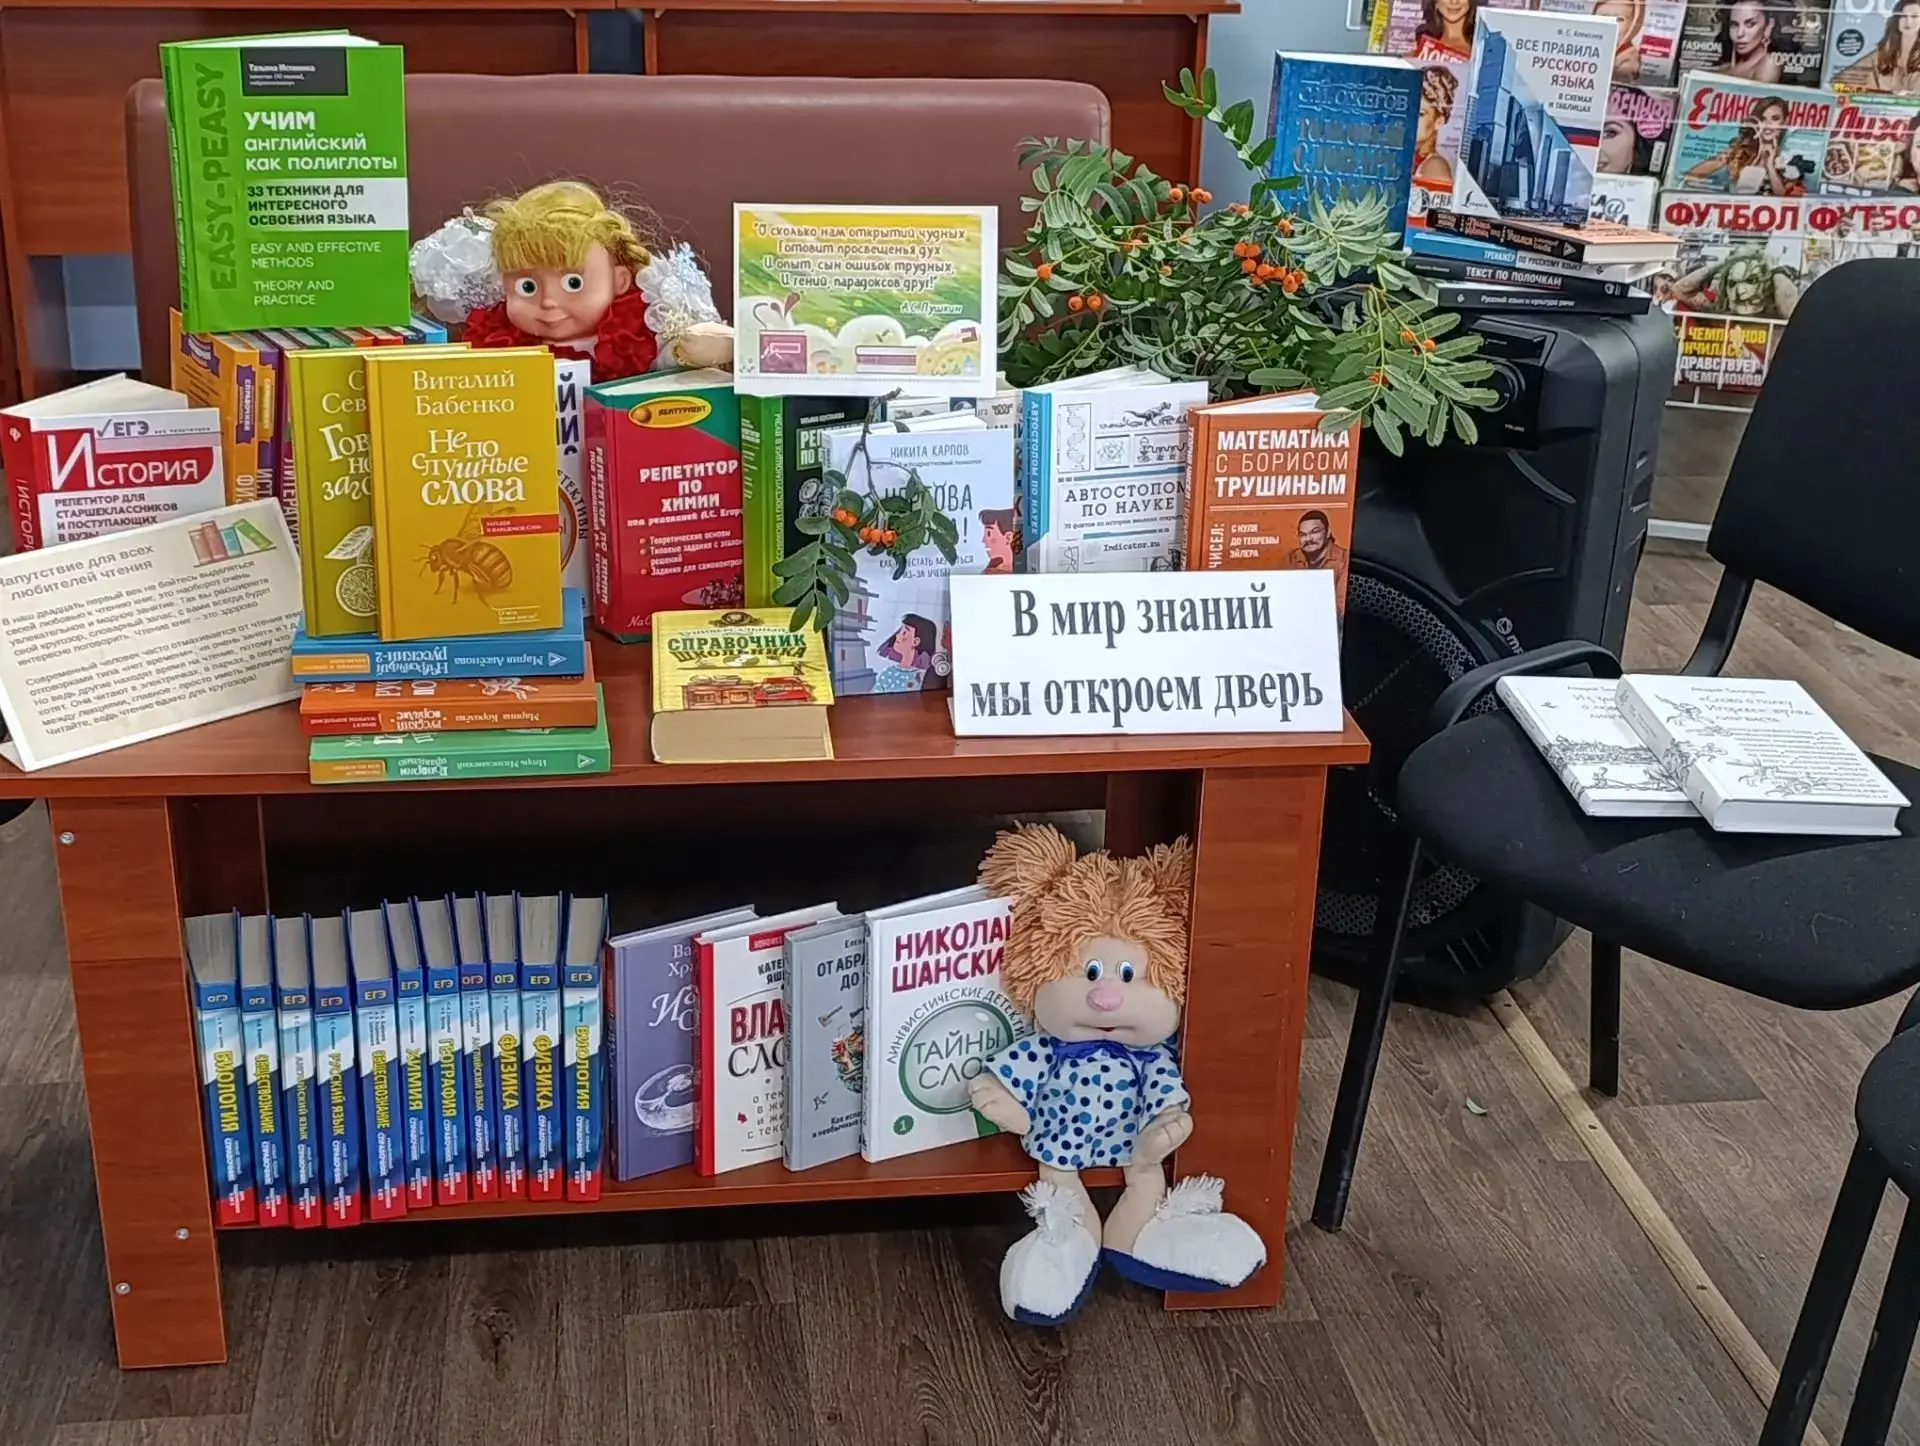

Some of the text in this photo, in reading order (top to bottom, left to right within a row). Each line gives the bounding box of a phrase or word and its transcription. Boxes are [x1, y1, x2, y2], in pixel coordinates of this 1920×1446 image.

[1515, 38, 1600, 58] ВСЕ ПРАВИЛА
[1532, 56, 1598, 74] РУССКОГО
[1550, 75, 1595, 90] ЯЗЫКА
[1565, 94, 1592, 102] СХЕМАХ
[1555, 102, 1591, 113] ТАБЛИЦАХ
[244, 111, 315, 131] УЧИМ
[245, 133, 366, 151] английский
[246, 156, 397, 171] как полиглоты
[195, 63, 238, 290] EASY-PEASY
[247, 185, 364, 198] 33 ТЕХНИКИ ДЛЯ
[249, 199, 348, 212] ИНТЕРЕСНОГО
[249, 213, 376, 226] ОСВОЕНИЯ ЯЗЫКА
[1665, 204, 1798, 231] ФУТБОЛ
[771, 227, 965, 240] сколько нам открытий чудных
[251, 241, 381, 254] EASY AND EFFECTIVE
[779, 243, 941, 257] Готовит просвещенья дух
[252, 257, 314, 268] METHODS
[765, 258, 774, 269] И
[818, 261, 841, 271] сын
[845, 260, 890, 271] ошибок
[1528, 257, 1561, 269] РУССКОМУ
[781, 275, 791, 286] И
[834, 278, 900, 290] парадоксов
[1466, 266, 1562, 287] ТЕКСТ ПО ПОЛОЧКАМ
[254, 280, 334, 291] THEORY AND
[254, 295, 316, 305] PRACTICE
[1481, 295, 1507, 304] Русский
[921, 302, 962, 314] Пушкин
[1689, 327, 1767, 344] ЧЕМПНОВ
[412, 370, 515, 391] Виталий
[416, 395, 515, 416] Бабенко
[113, 420, 149, 437] ЕГЭ
[1218, 429, 1350, 450] МАТЕМАТИКА
[890, 444, 969, 458] НИКИТА КАРПОВ
[1031, 401, 1040, 535] АВТОСТОПОМ ПО НАУКЕ
[1216, 451, 1348, 473] С БОРИСОМ
[640, 460, 738, 483] РЕПЕТИТОР
[421, 476, 526, 507] слова
[678, 480, 702, 496] ПО
[1215, 475, 1346, 498] ТРУШИНЫМ
[55, 492, 145, 507] РЕПЕТИТОР ДЛЯ
[661, 493, 720, 512] ХИМИИ
[1081, 498, 1174, 517] ПО НАУКЕ
[56, 503, 178, 519] СТАРШЕКЛАССНИКОВ
[57, 515, 158, 531] И ПОСТУПАЮЩИХ
[627, 518, 645, 527] под
[1238, 524, 1258, 533] НУЛЯ
[58, 531, 99, 542] В ВУЗЫ
[704, 530, 731, 540] основы
[1231, 535, 1280, 547] ДО ТЕОРЕМЫ
[1103, 541, 1161, 552] Indicator.ru
[1229, 548, 1259, 559] ЭЙЛЕРА
[88, 553, 116, 570] для
[119, 545, 155, 560] всех
[650, 564, 696, 576] Задания для
[11, 560, 153, 601] любителей чтения
[1010, 582, 1273, 649] В мир знаний
[667, 634, 806, 651] СПРАВОЧНИК
[454, 655, 543, 668] Мария Аксёнова
[970, 670, 1324, 728] мы откроем дверь
[503, 712, 540, 722] Марина
[457, 758, 547, 770] Игорь Милославский
[817, 960, 833, 977] ОТ
[462, 975, 484, 985] ОГЭ
[494, 974, 515, 984] ОГЭ
[530, 975, 551, 985] ЕГЭ
[571, 972, 593, 982] ЕГЭ
[840, 973, 859, 991] ДО
[401, 980, 420, 991] ЕГЭ
[730, 998, 784, 1046] ВЛА
[887, 987, 982, 1064] ЛИНГВИСТИЧЕСКИЕ
[913, 1027, 1001, 1065] ТАЙНЫ
[498, 1034, 520, 1110] ФИЗИКА
[533, 1034, 553, 1111] ФИЗИКА
[575, 1026, 590, 1110] БИОЛОГИЯ
[407, 1048, 424, 1111] ХИМИЯ
[439, 1038, 457, 1117] ГЕОГРАФИЯ
[213, 1050, 239, 1133] БИОЛОГИЯ
[255, 1053, 275, 1134] ОБЩЕСТВОЗНАНИЕ
[329, 1053, 346, 1136] РУССКИЙ ЯЗЫК
[372, 1050, 390, 1129] ОБЩЕСТВОЗНАНИЕ
[899, 1120, 907, 1131] 1
